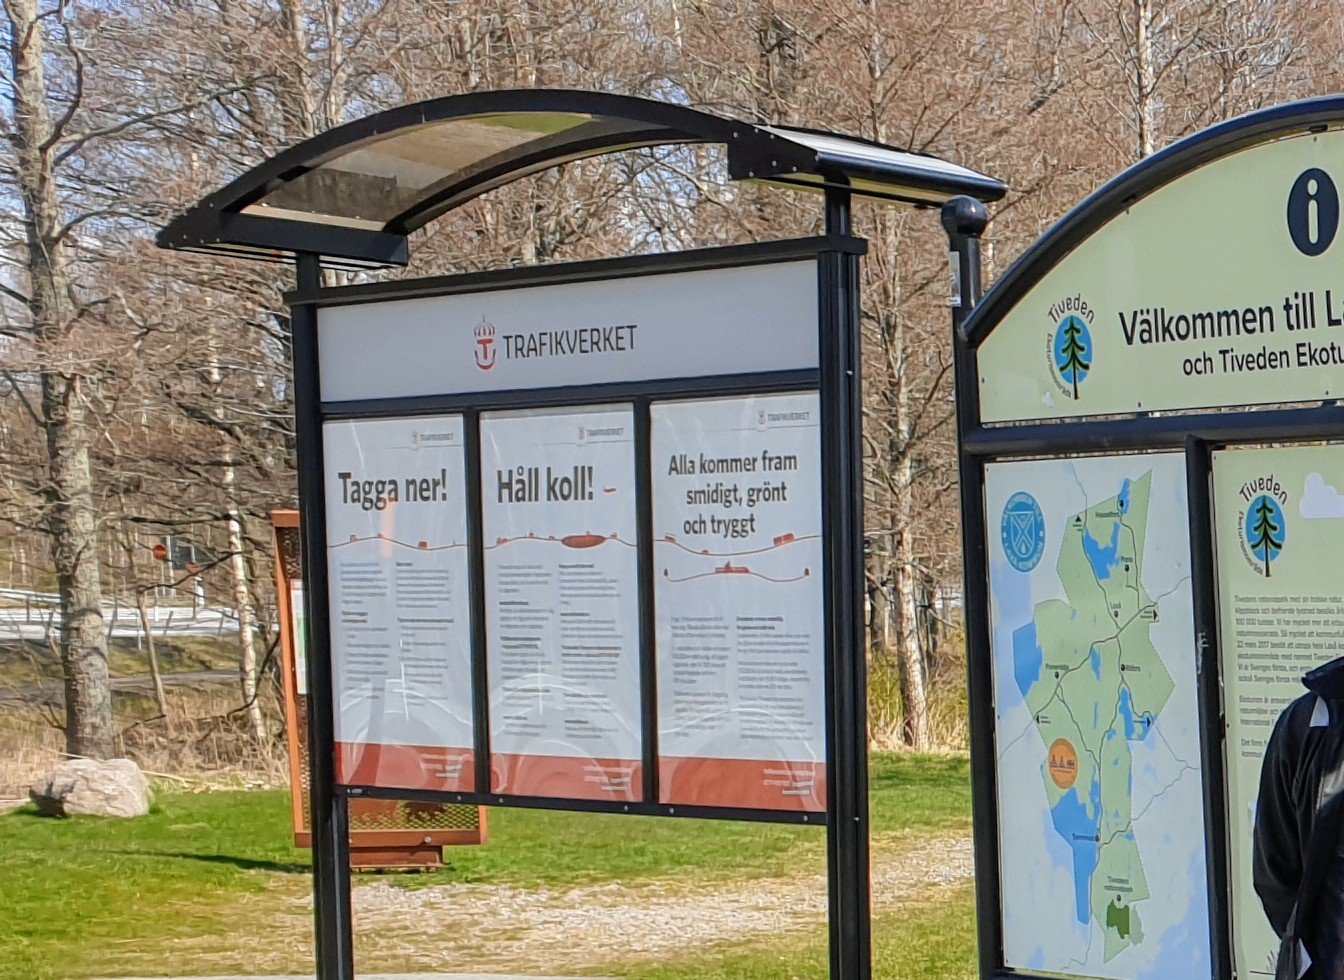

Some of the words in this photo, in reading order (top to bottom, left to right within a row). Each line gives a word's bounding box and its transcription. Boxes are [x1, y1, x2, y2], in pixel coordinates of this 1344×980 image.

[1047, 293, 1095, 324] Tiveden
[1118, 303, 1275, 346] Välkommen
[1283, 291, 1316, 331] till
[502, 325, 638, 360] TRAFIKVERKET
[1182, 351, 1214, 376] och
[1218, 346, 1290, 373] Tiveden
[668, 455, 696, 476] Alla
[699, 453, 757, 474] kommer
[762, 450, 798, 471] fram
[338, 472, 399, 511] Tagga
[405, 468, 447, 502] ner!
[497, 465, 539, 503] Håll
[546, 465, 594, 502] koll!
[686, 483, 743, 508] smidigt,
[747, 481, 787, 508] grönt
[1239, 474, 1288, 505] Tiveden
[683, 514, 706, 535] och
[711, 513, 755, 538] tryggt
